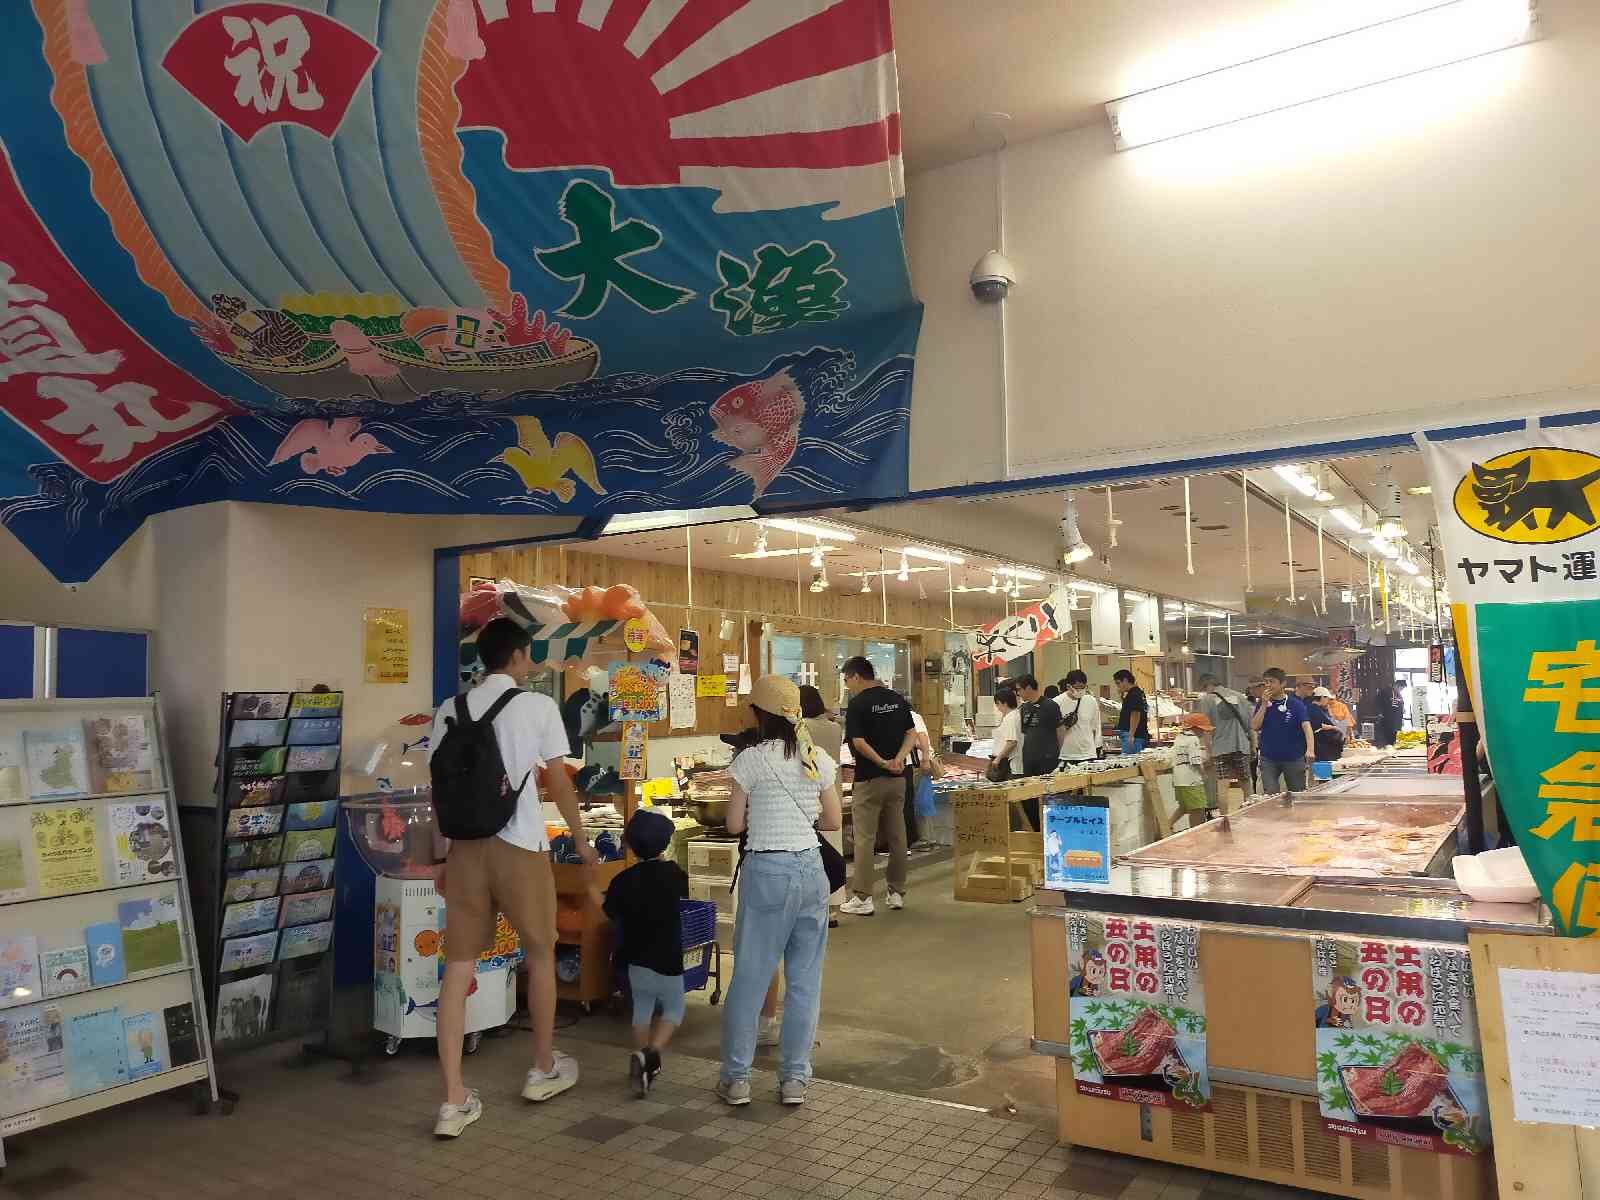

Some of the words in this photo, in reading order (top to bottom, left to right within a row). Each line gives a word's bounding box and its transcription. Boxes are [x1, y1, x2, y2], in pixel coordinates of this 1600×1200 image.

[222, 14, 324, 114] 祝
[534, 178, 850, 337] 大漁
[1457, 550, 1598, 585] ヤマト運
[1104, 916, 1130, 993] 丑の日
[1132, 919, 1159, 995] 土用の
[1360, 940, 1392, 1025] 丑の日
[1393, 944, 1425, 1026] 土用の
